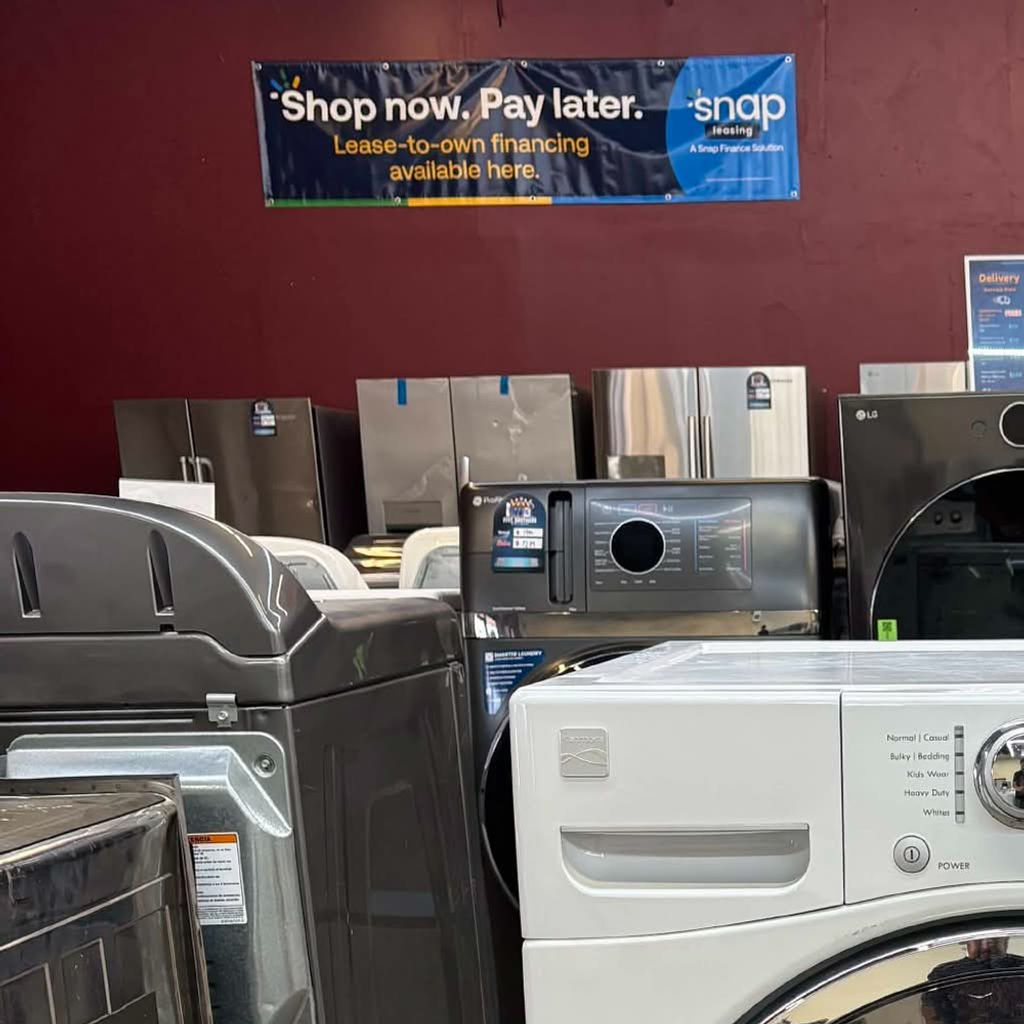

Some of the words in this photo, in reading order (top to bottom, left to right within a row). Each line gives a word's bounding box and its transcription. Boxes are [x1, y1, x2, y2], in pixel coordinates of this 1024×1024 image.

[281, 87, 380, 129] Shop
[385, 93, 471, 122] now.
[481, 86, 545, 127] Pay
[553, 87, 643, 120] later.
[692, 91, 786, 131] snap
[712, 125, 753, 137] leasing
[334, 134, 484, 155] Lease-to-own
[490, 133, 589, 157] financing
[690, 144, 697, 153] A
[720, 144, 750, 153] Finance
[752, 142, 784, 153] Solution
[389, 160, 480, 181] available
[487, 160, 540, 180] here.
[978, 272, 1020, 285] Delivery
[866, 410, 878, 419] LG
[886, 733, 917, 742] Normal
[923, 733, 949, 742] Casual
[890, 751, 912, 762] Bulky
[917, 751, 950, 761] Bedding
[907, 769, 926, 778] Kids
[928, 770, 949, 778] Wear
[904, 789, 928, 798] Heavy
[931, 788, 950, 798] Duty
[923, 808, 950, 817] Whites
[938, 862, 970, 870] POWER
